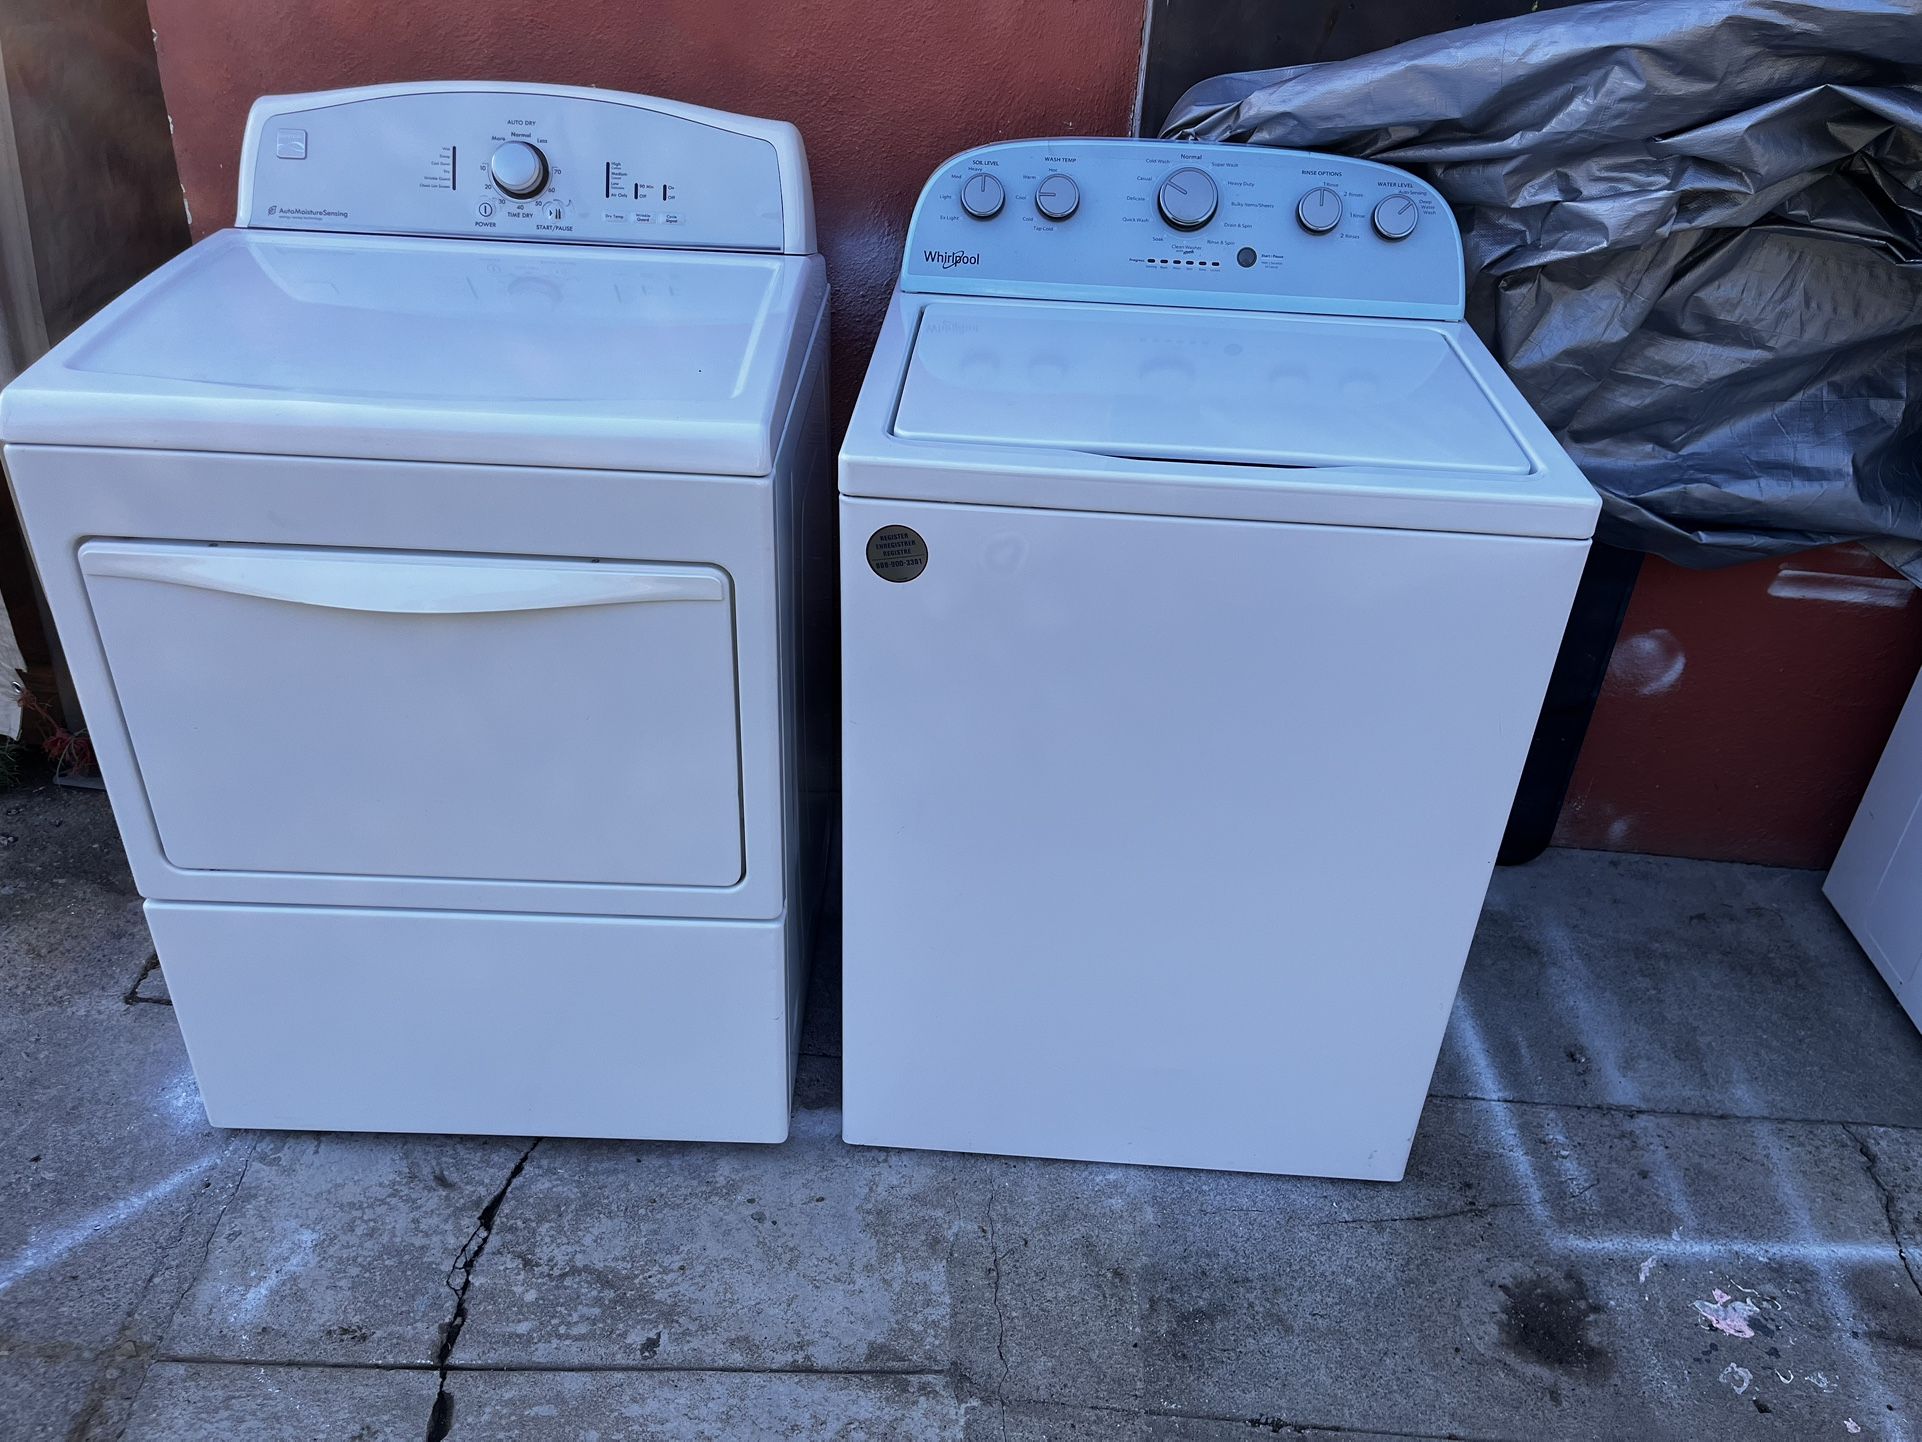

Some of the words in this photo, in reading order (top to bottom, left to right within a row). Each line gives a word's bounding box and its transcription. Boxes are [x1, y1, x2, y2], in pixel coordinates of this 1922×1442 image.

[279, 208, 348, 218] AutoMoistureSensing
[924, 250, 980, 269] Whirlpool
[880, 532, 909, 542] REGISTER
[876, 540, 916, 550] ENREGISTRER
[882, 548, 912, 557] REGISTRE
